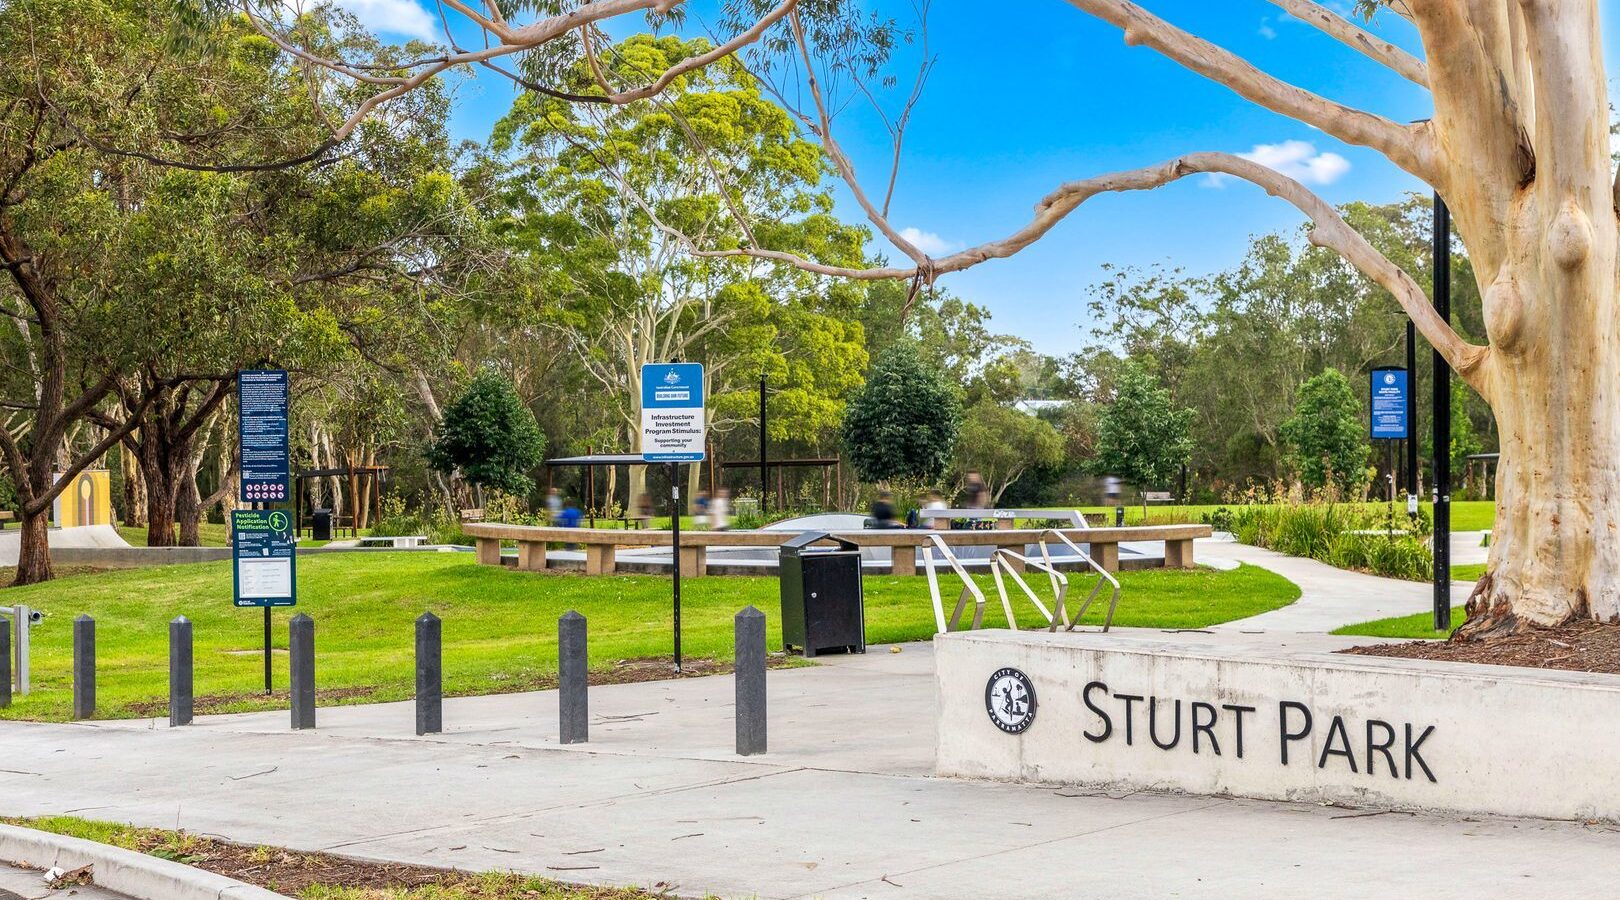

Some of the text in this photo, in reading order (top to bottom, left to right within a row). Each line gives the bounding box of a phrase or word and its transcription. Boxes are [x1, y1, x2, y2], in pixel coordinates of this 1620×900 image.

[994, 670, 1024, 680] CITY OF
[989, 708, 1032, 731] PARRAMATTA
[1083, 681, 1436, 782] STURT PARK
